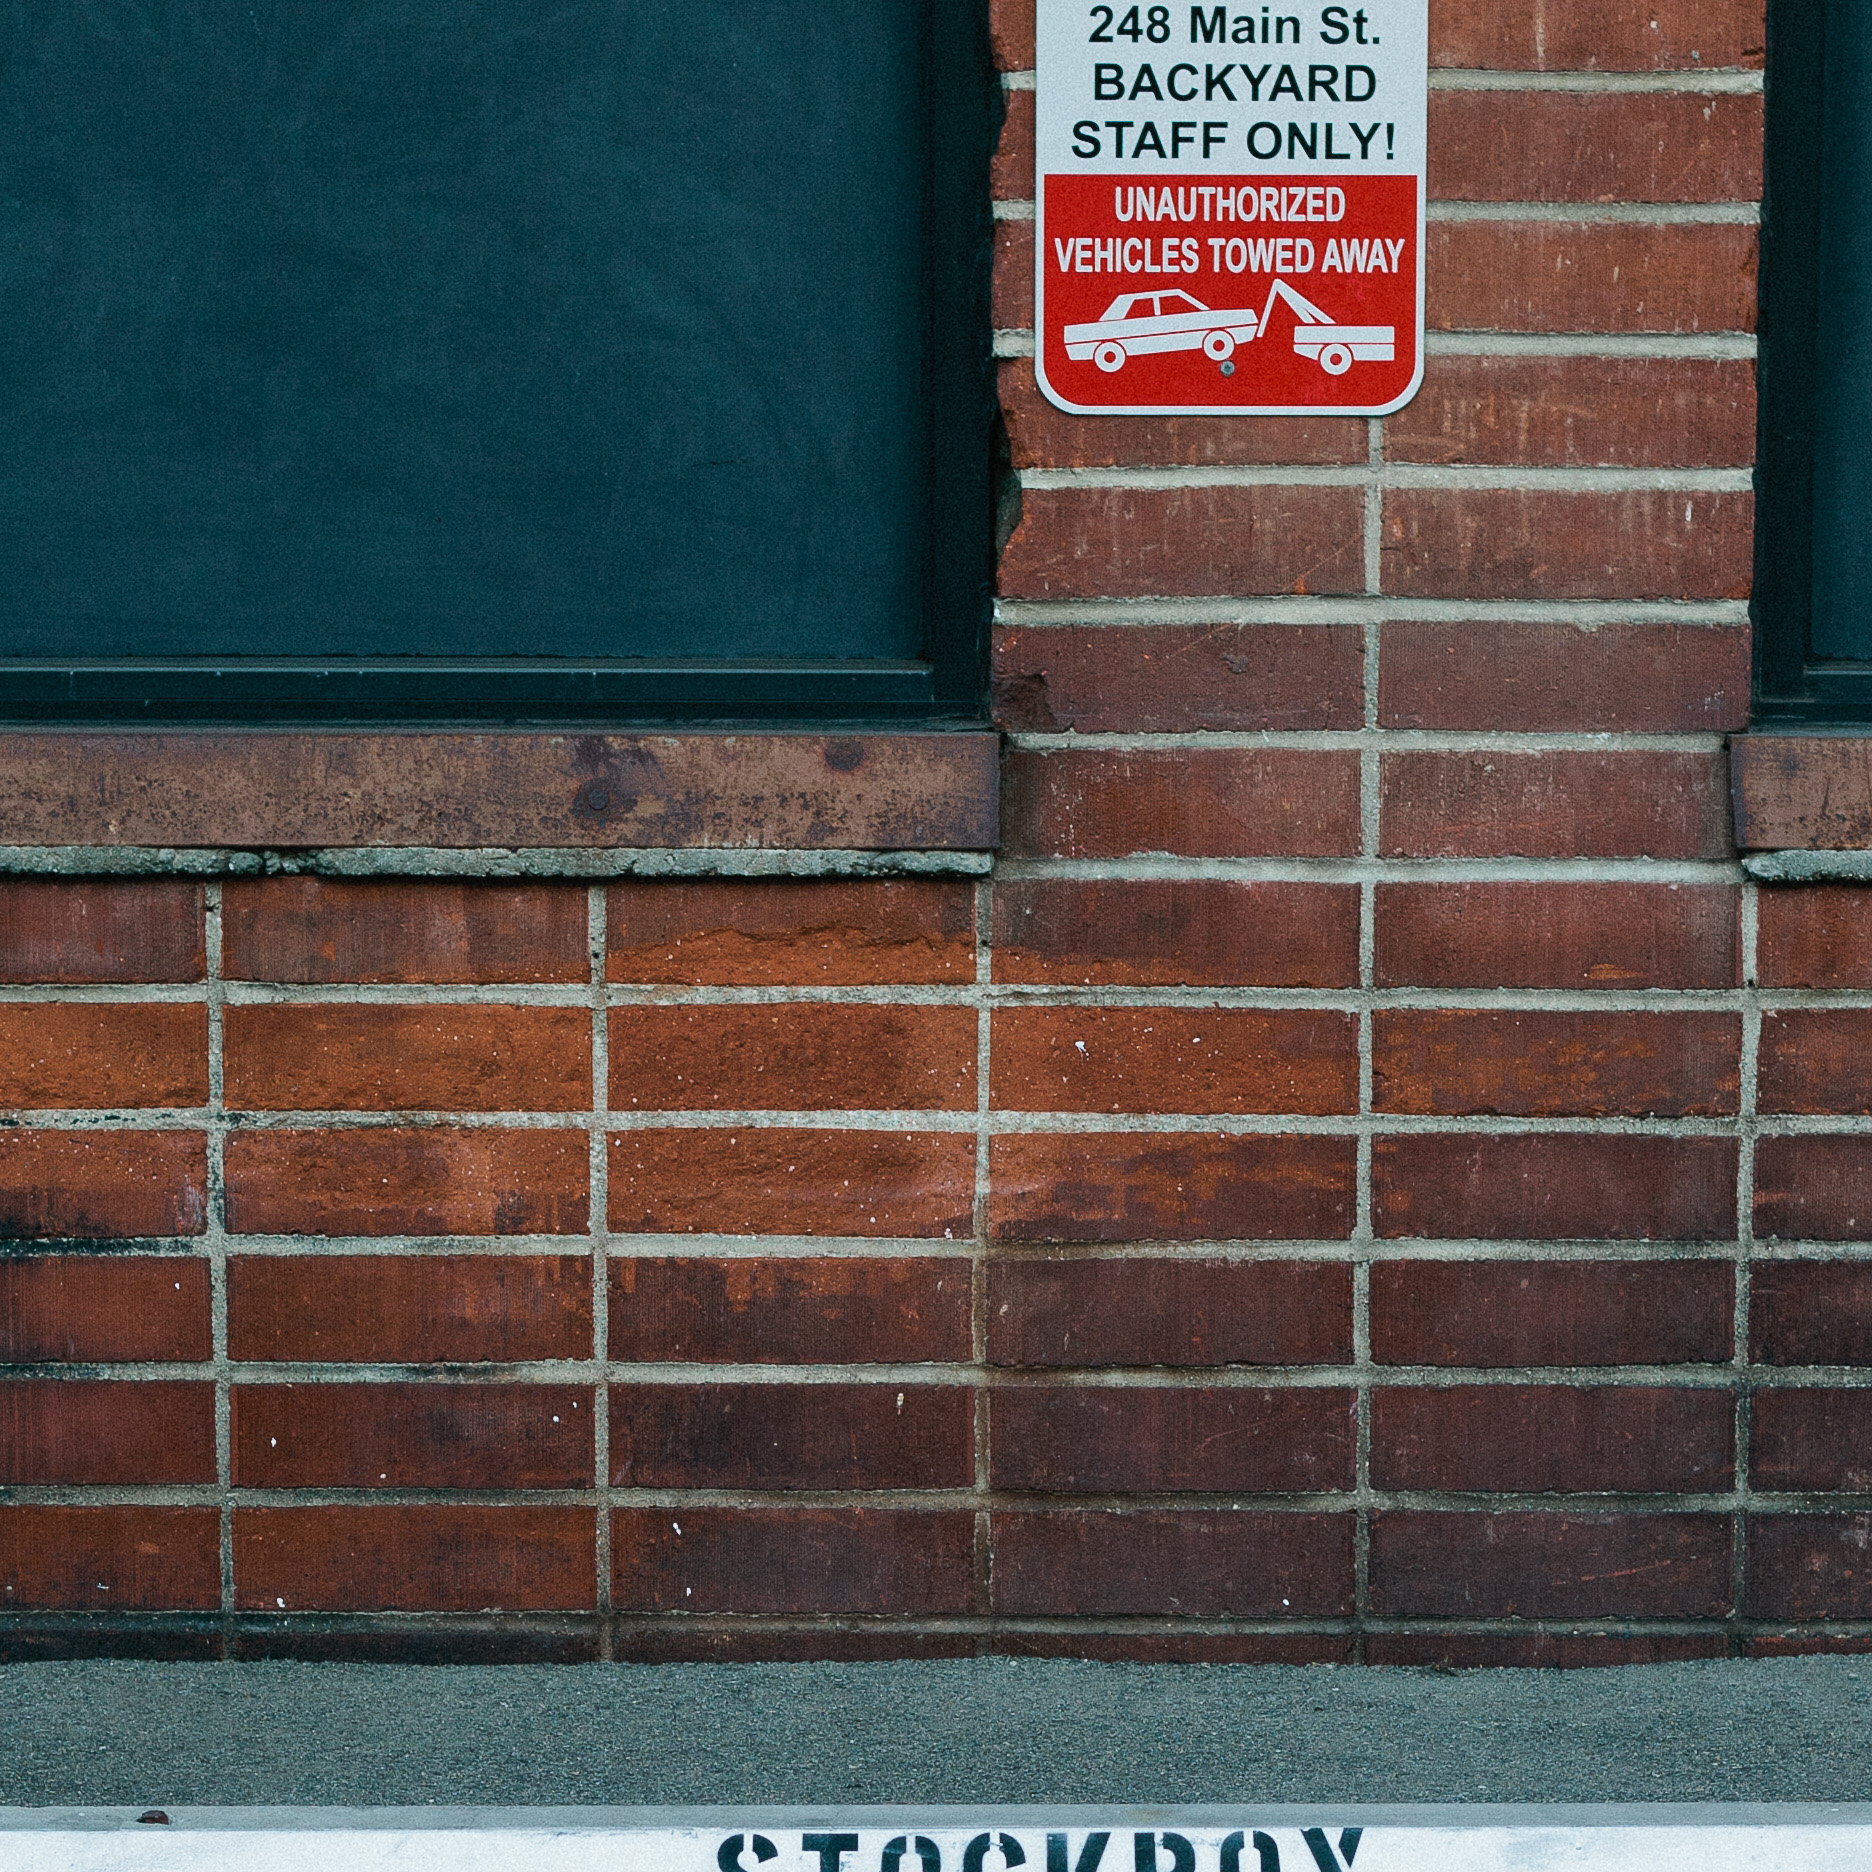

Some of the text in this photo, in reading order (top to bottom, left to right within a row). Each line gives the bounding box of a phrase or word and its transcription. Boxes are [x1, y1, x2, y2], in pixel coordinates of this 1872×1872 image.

[1088, 5, 1381, 45] 248 Main St.
[1094, 63, 1377, 102] BACKYARD
[1071, 120, 1395, 160] STAFF ONLY!
[1114, 186, 1346, 222] UNAUTHORIZED
[1054, 237, 1405, 273] VEHICLES TOWED AWAY
